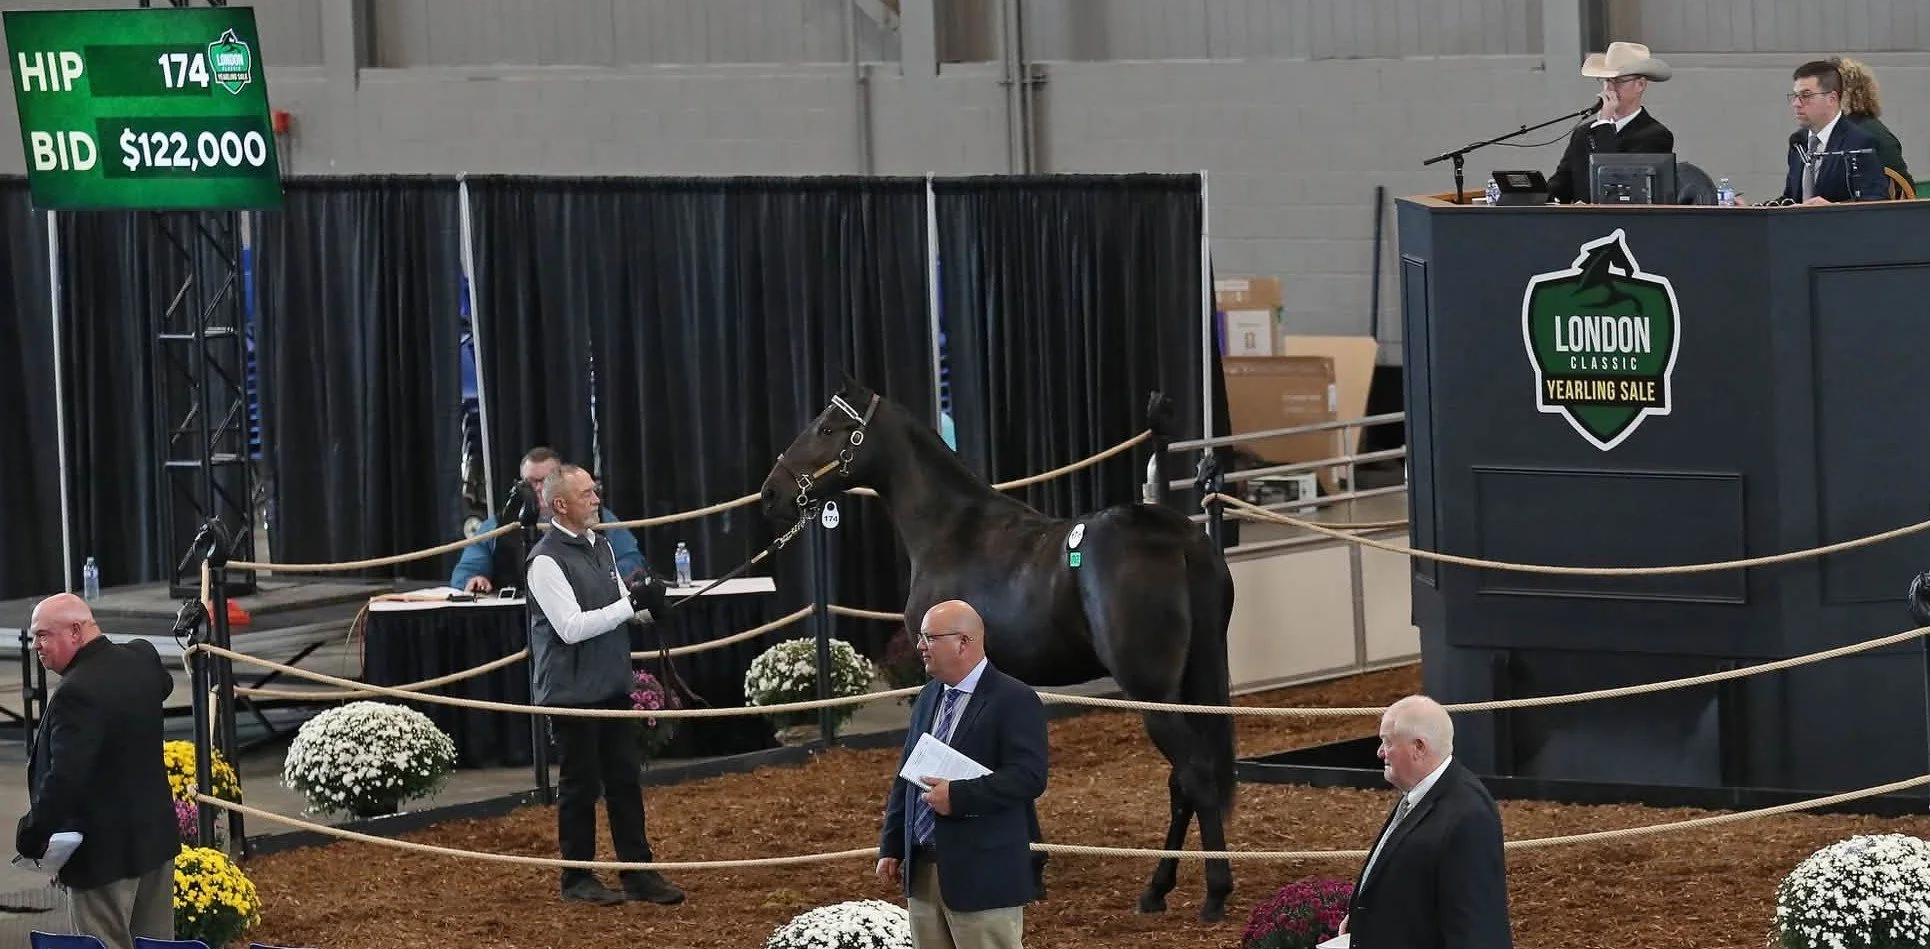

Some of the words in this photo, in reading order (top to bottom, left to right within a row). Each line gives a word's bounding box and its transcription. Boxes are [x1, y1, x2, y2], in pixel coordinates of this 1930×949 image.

[18, 52, 84, 92] HIP
[158, 53, 209, 88] 174
[216, 53, 244, 66] LONDON
[31, 131, 97, 171] BID
[119, 128, 267, 171] $122,000
[1554, 315, 1651, 353] LONDON
[1570, 356, 1638, 370] CLASSIC
[1546, 379, 1616, 401] YEARLING
[1620, 380, 1656, 402] SALE
